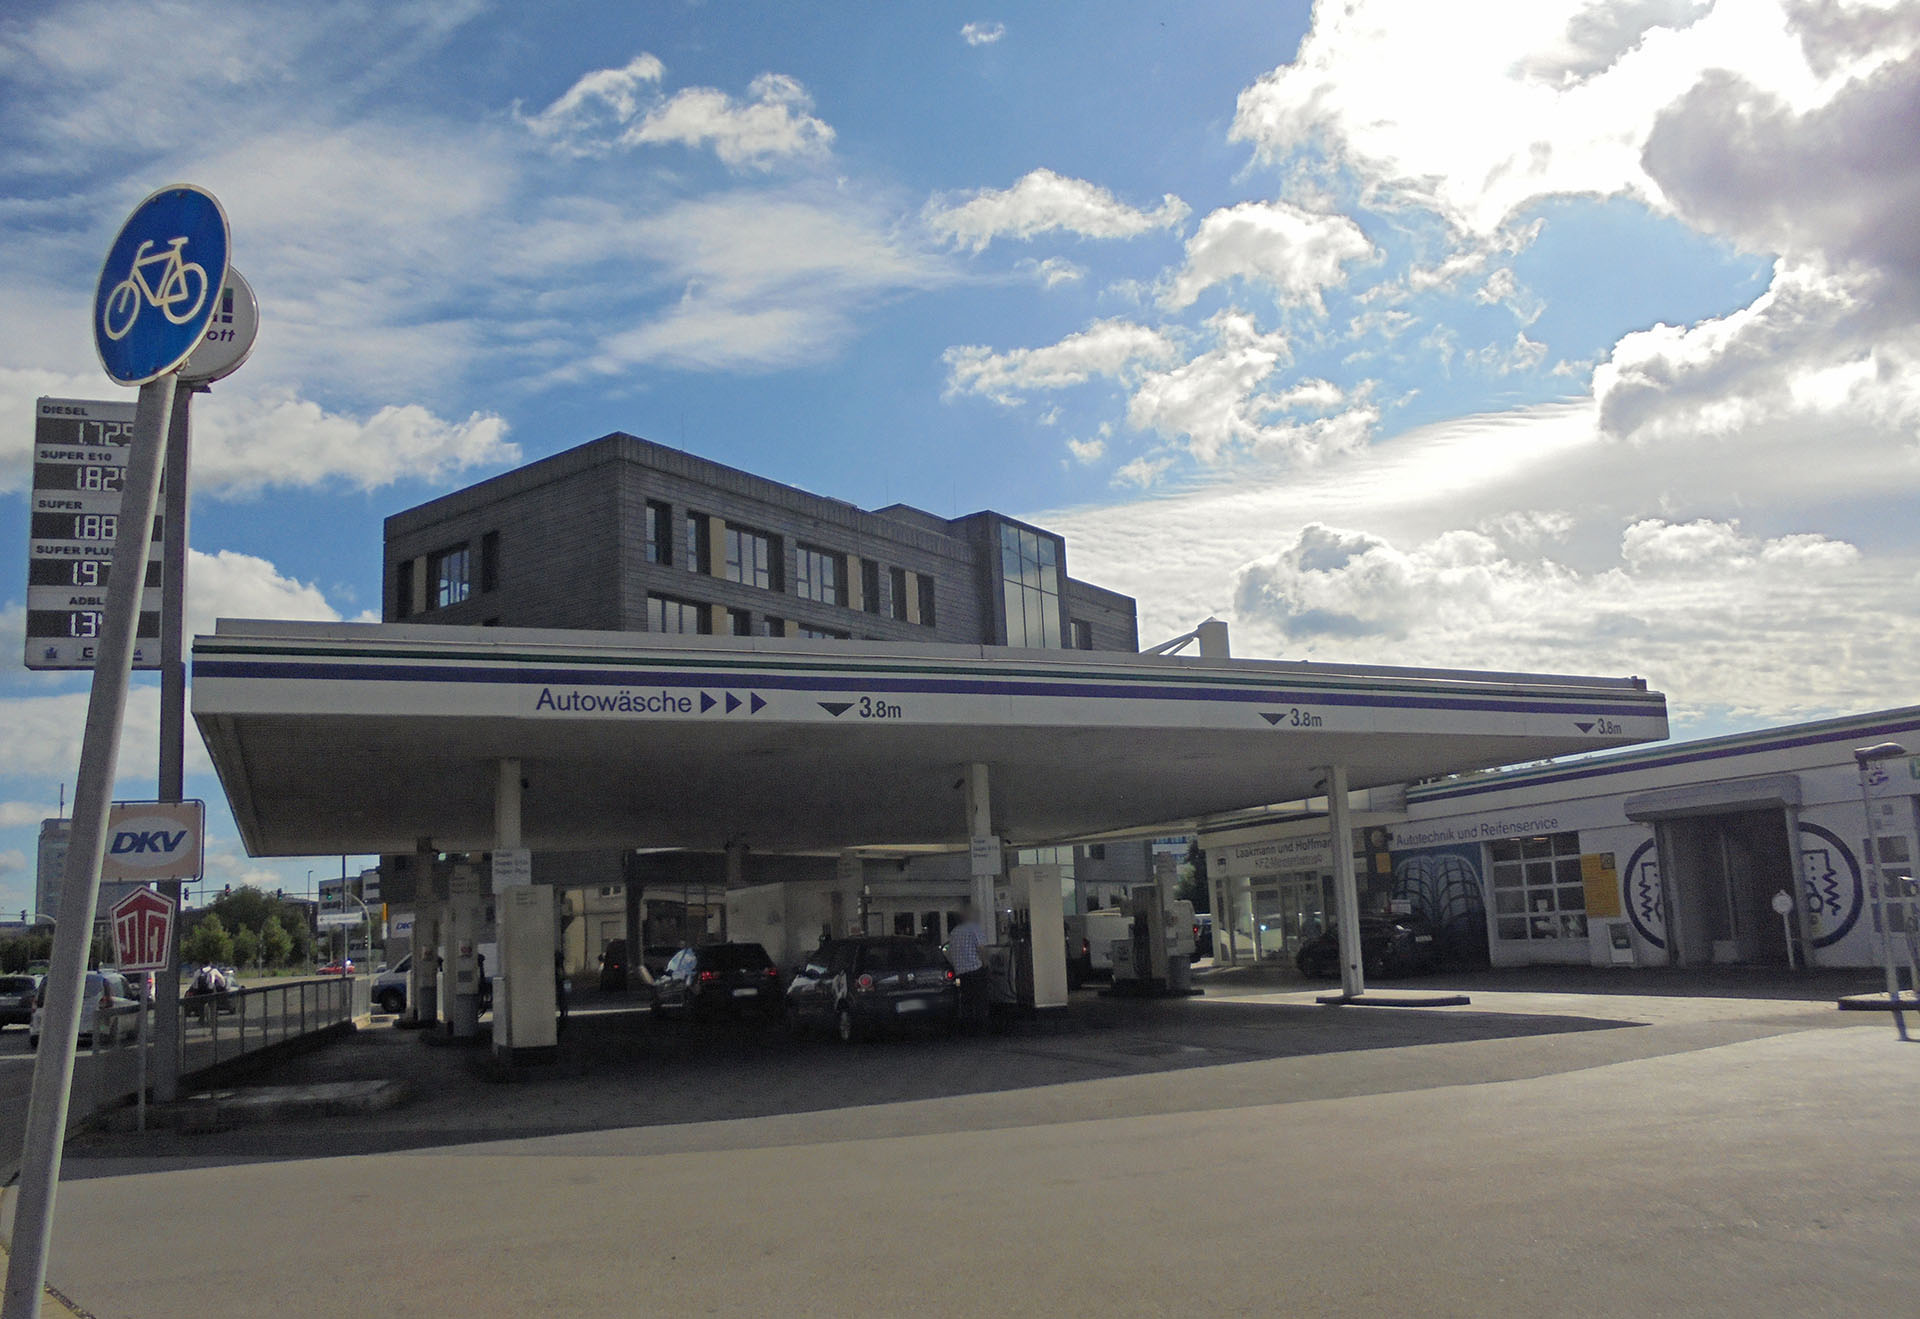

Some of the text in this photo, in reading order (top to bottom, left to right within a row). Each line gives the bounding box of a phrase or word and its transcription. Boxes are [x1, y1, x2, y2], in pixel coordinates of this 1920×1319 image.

[42, 406, 88, 416] DIESEL
[40, 450, 112, 461] SUPER E10
[38, 500, 82, 509] SUPER
[36, 545, 80, 555] SUPER
[535, 688, 692, 713] Autowäsche
[858, 696, 902, 719] 3.8m
[1290, 708, 1322, 728] 3.8m
[1597, 718, 1622, 735] 3.8m
[1396, 817, 1559, 847] Autotechnik und Reifenservice
[110, 830, 188, 854] DKV
